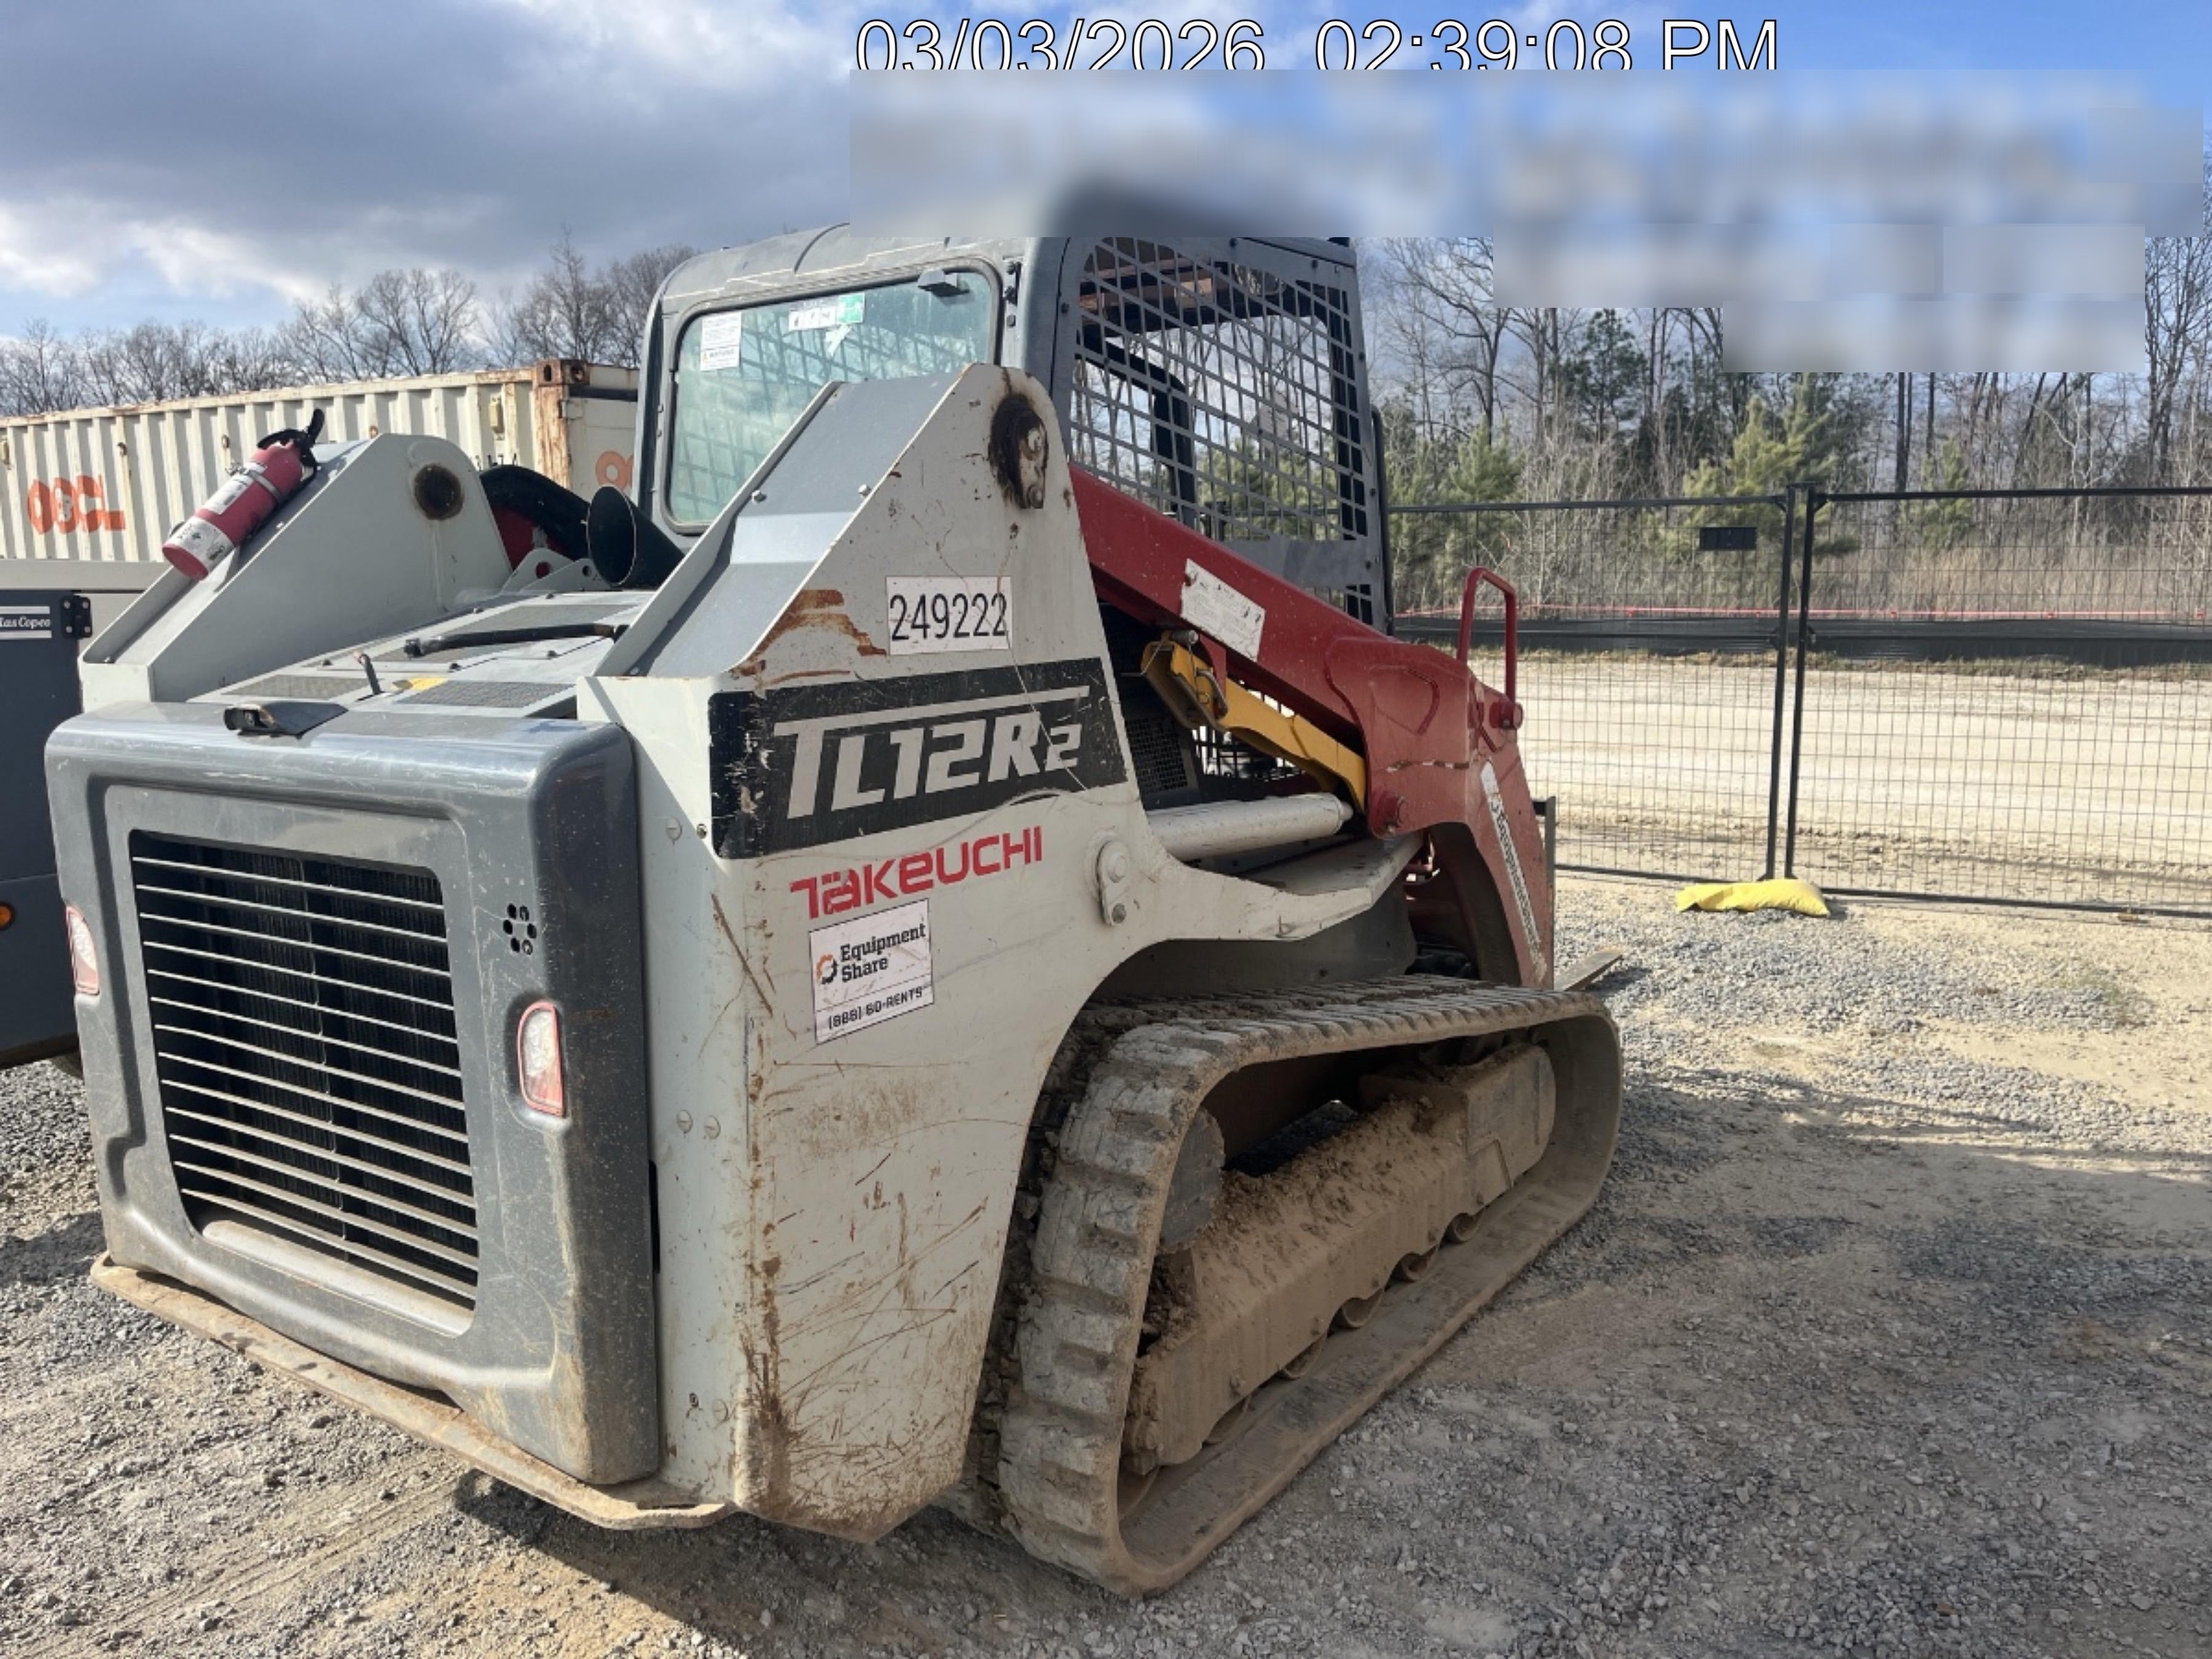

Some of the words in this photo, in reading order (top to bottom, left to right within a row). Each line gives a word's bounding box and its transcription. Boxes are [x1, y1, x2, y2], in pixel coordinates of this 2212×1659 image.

[889, 592, 1008, 640] 249222
[774, 685, 1090, 819] TL12R2
[840, 923, 926, 963] Equipment
[841, 957, 888, 983] Share
[828, 1006, 862, 1030] (888)
